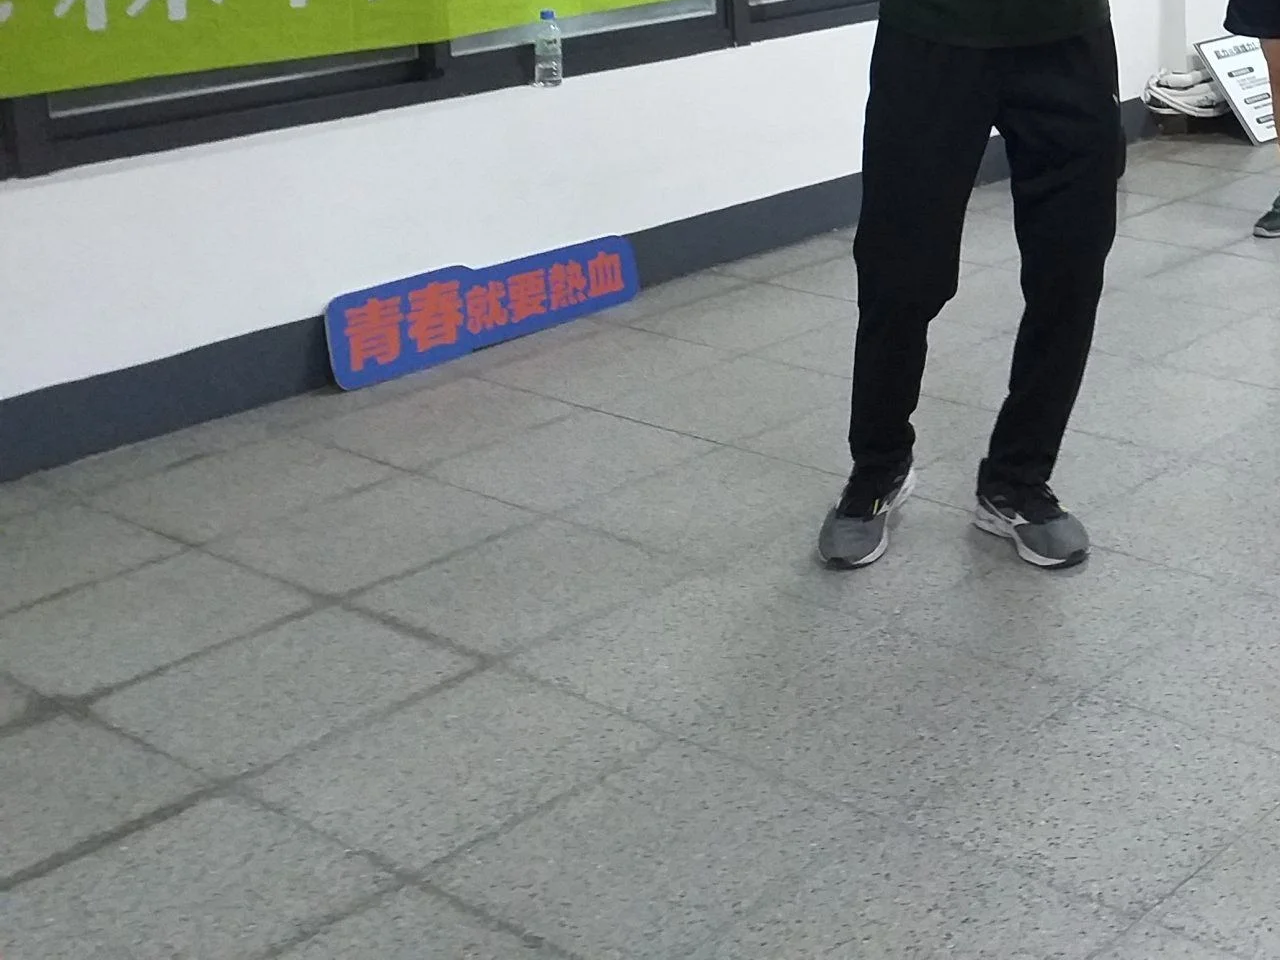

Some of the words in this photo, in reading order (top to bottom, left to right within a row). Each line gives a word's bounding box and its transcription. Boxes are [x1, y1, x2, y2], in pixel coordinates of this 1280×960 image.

[344, 251, 625, 372] 青春就要熱血
